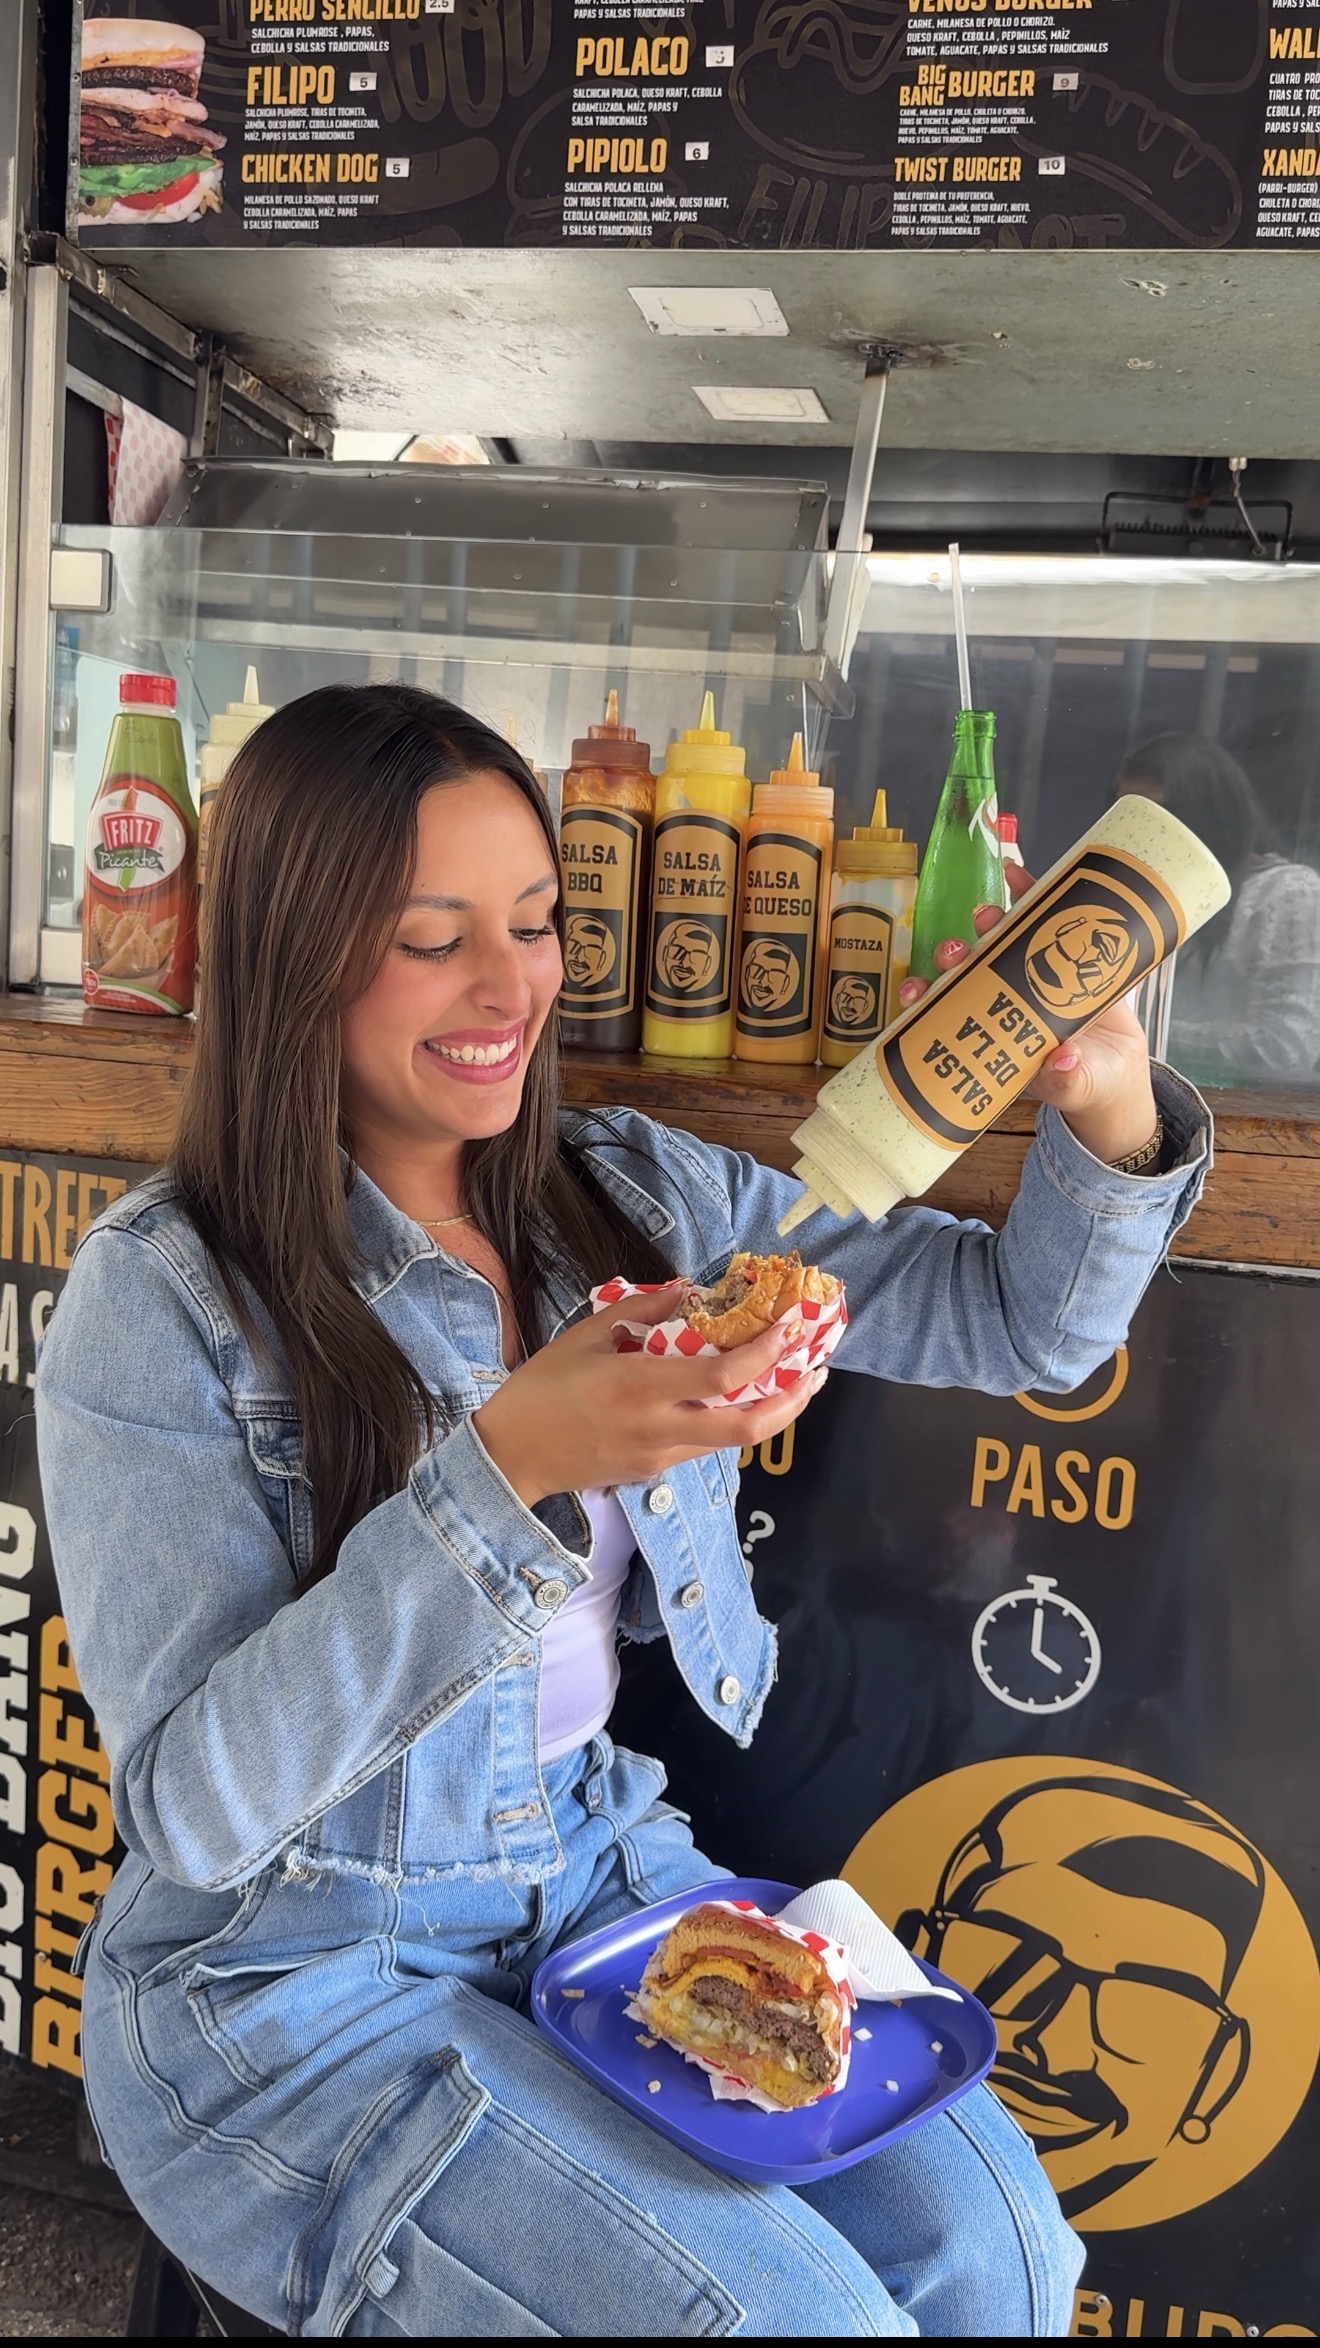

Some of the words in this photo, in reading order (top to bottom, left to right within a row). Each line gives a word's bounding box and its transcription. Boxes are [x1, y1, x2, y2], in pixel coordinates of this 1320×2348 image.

[429, 0, 449, 8] 2.5
[250, 0, 316, 22] PERRO
[322, 0, 420, 21] SENCILLO
[574, 9, 596, 19] PAPAS
[598, 9, 603, 18] Y
[604, 8, 631, 18] SALSAS
[633, 8, 685, 18] TRADICIONALES
[908, 19, 934, 29] CARNE,
[937, 18, 974, 29] MILANESA
[976, 18, 986, 28] DE
[988, 17, 1011, 28] POLLO
[1014, 17, 1019, 27] O
[1021, 16, 1055, 27] CHORIZO.
[252, 27, 294, 38] SALCHICHA
[346, 26, 375, 37] PAPAS,
[907, 32, 931, 43] QUESO
[933, 32, 959, 42] KRAFT,
[962, 31, 994, 42] CEBOLLA
[1001, 31, 1048, 41] PEPINILLOS,
[251, 42, 285, 53] CEBOLLA
[287, 42, 292, 53] Y
[294, 42, 325, 52] SALSAS
[328, 41, 389, 52] TRADICIONALES
[906, 46, 937, 56] TOMATE,
[939, 45, 981, 56] AGUACATE,
[983, 45, 1008, 55] PAPAS
[1010, 45, 1015, 55] Y
[1018, 44, 1047, 54] SALSAS
[1049, 43, 1108, 54] TRADICIONALES
[1269, 28, 1320, 59] WAL
[576, 36, 689, 76] POLACO
[918, 64, 946, 85] BIG
[1270, 73, 1300, 84] CUATRO
[246, 65, 335, 105] FILIPO
[360, 78, 368, 88] 5
[948, 70, 1035, 97] BURGER
[1061, 78, 1069, 88] 9
[573, 88, 610, 98] SALCHICHA
[612, 88, 640, 98] POLACA,
[642, 88, 664, 98] QUESO
[666, 88, 690, 98] KRAFT,
[692, 87, 722, 97] CEBOLLA
[899, 86, 944, 106] BANG
[1269, 90, 1291, 101] TIRAS
[1293, 90, 1303, 101] DE
[572, 102, 625, 113] CARAMELIZADA,
[627, 101, 646, 113] MAÍZ,
[648, 102, 671, 112] PAPAS
[672, 102, 678, 112] Y
[1267, 106, 1300, 117] CEBOLLA
[572, 116, 593, 126] SALSA
[595, 116, 647, 126] TRADICIONALES
[1265, 122, 1291, 133] PAPAS
[1293, 122, 1298, 133] Y
[567, 138, 667, 173] PIPIOLO
[693, 148, 700, 159] 6
[242, 154, 330, 183] CHICKEN
[337, 154, 378, 183] DOG
[392, 164, 400, 175] 5
[895, 157, 948, 182] TWIST
[952, 157, 1022, 182] BURGER
[1044, 160, 1060, 170] 10
[565, 182, 602, 192] SALCHICHA
[604, 182, 631, 192] POLACA
[633, 182, 663, 192] RELLENA
[564, 197, 578, 208] CON
[580, 197, 601, 208] TIRAS
[602, 197, 612, 208] DE
[613, 197, 648, 208] TOCINETA,
[650, 196, 677, 208] JAMÓN,
[680, 197, 702, 208] QUESO
[704, 197, 729, 208] KRAFT,
[1259, 198, 1290, 208] CHULETA
[1291, 198, 1296, 208] O
[563, 212, 593, 222] CEBOLLA
[595, 212, 650, 222] CARAMELIZADA,
[652, 210, 672, 222] MAÍZ,
[674, 212, 698, 221] PAPAS
[1258, 212, 1281, 223] QUESO
[1282, 212, 1307, 223] KRAFT,
[562, 226, 568, 236] Y
[569, 226, 596, 236] SALSAS
[598, 226, 652, 236] TRADICIONALES
[1256, 227, 1295, 238] AGUACATE,
[111, 819, 153, 846] FRITZ
[99, 850, 158, 868] Picante
[562, 843, 618, 865] SALSA
[664, 851, 721, 871] SALSA
[568, 872, 602, 894] BBQ
[658, 878, 676, 895] DE
[680, 874, 726, 898] MAÍZ
[748, 870, 800, 890] SALSA
[754, 897, 812, 916] QUESO
[835, 937, 883, 951] MOSTAZA
[987, 991, 1046, 1058] CASA
[956, 1016, 996, 1059] LA
[984, 1048, 1020, 1088] DE
[922, 1038, 993, 1116] SALSA
[970, 1436, 1137, 1531] PASO
